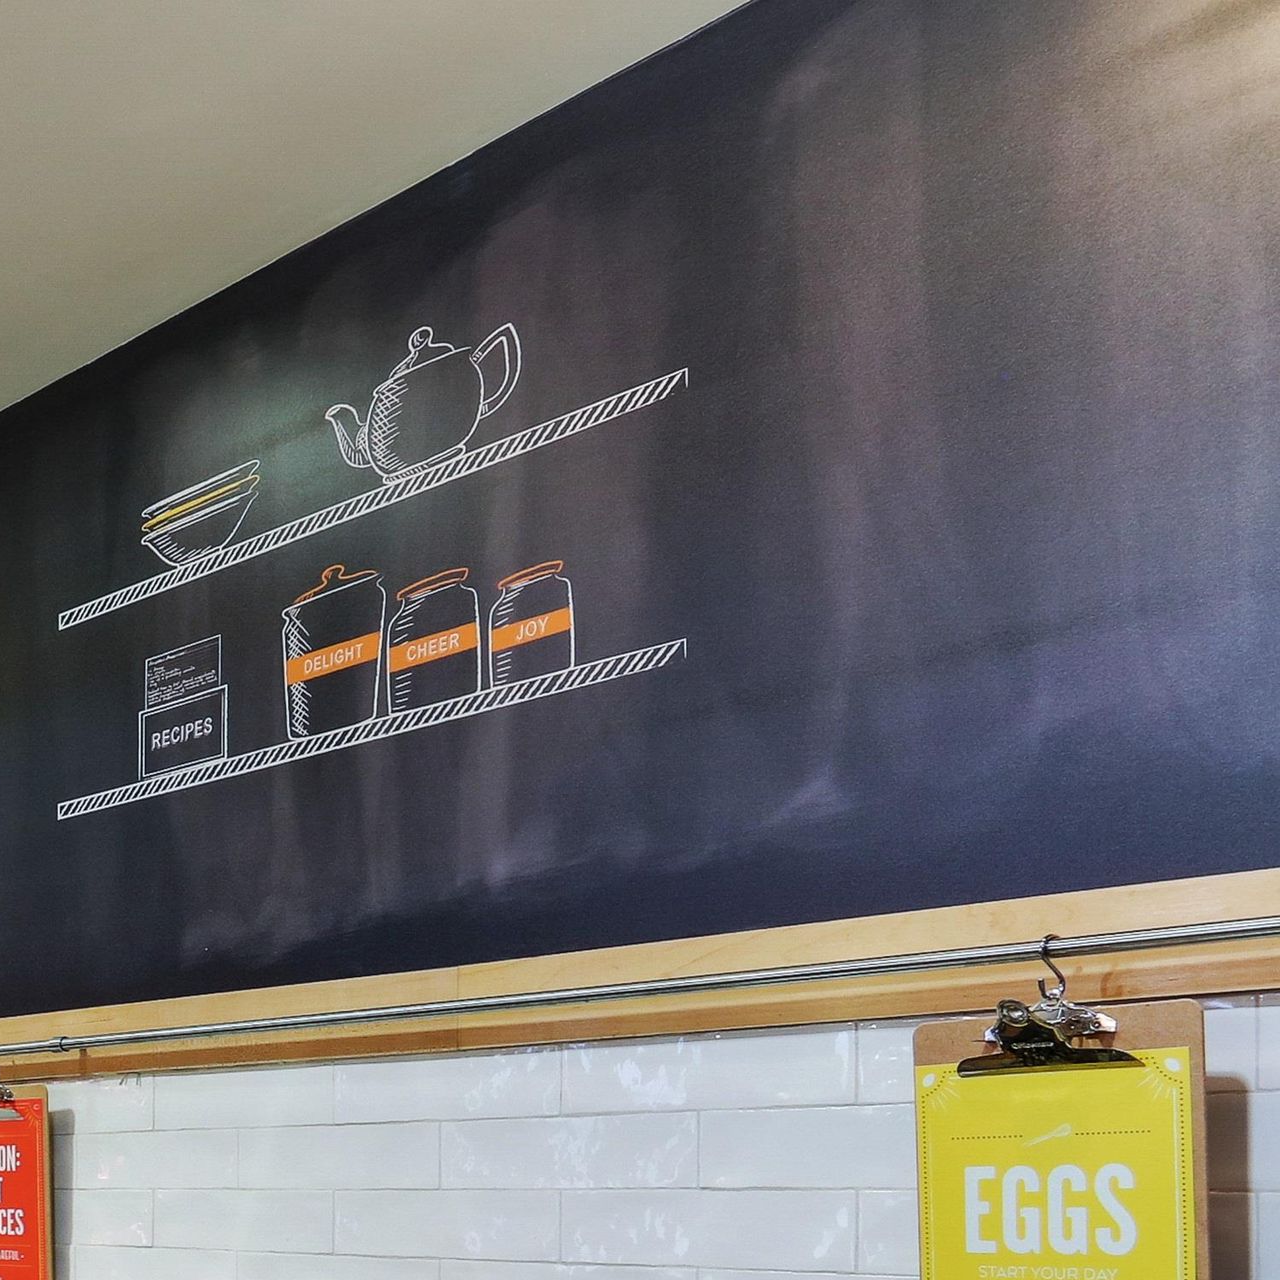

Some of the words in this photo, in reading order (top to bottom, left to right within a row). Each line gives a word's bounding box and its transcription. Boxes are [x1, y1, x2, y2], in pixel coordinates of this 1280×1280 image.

[515, 617, 550, 642] JOY
[303, 644, 364, 674] DELIGHT
[405, 633, 460, 662] CHEER
[151, 717, 213, 751] RECIPES
[964, 1163, 1138, 1256] EGGS
[978, 1265, 1028, 1279] START
[1031, 1266, 1080, 1280] YOUR
[1084, 1267, 1119, 1280] DAY
